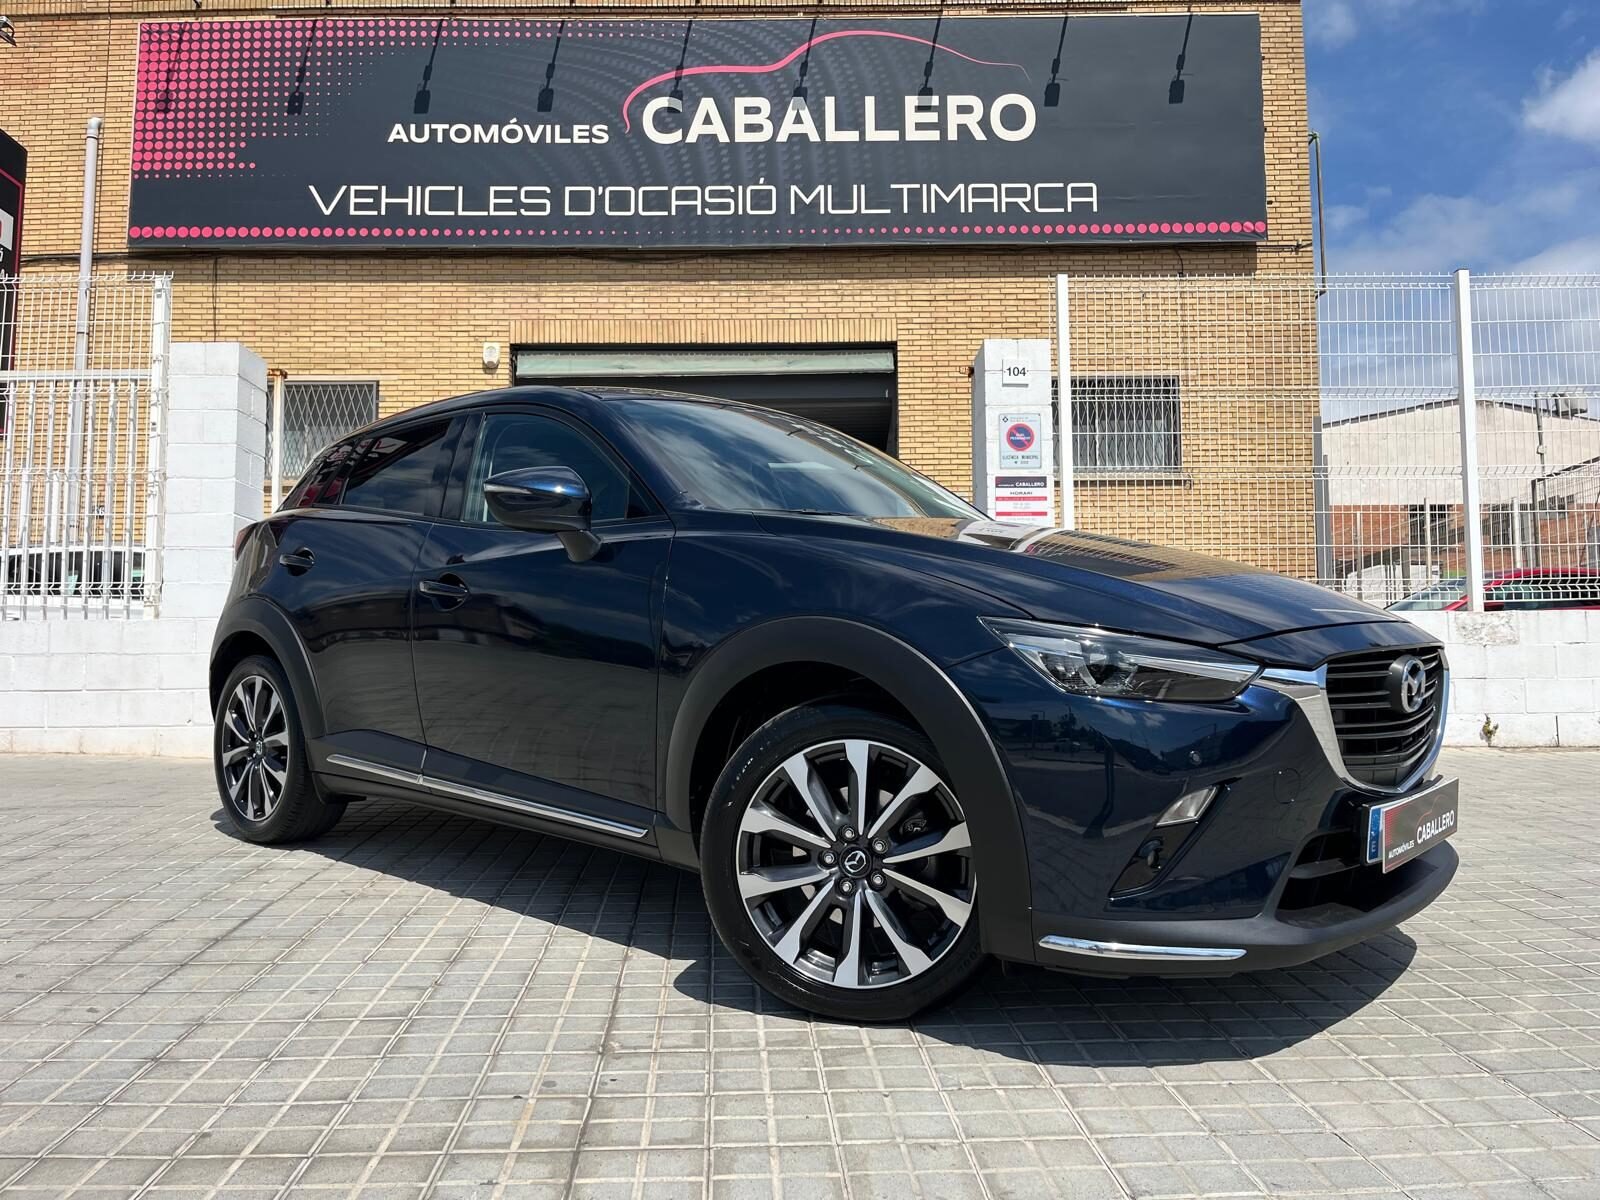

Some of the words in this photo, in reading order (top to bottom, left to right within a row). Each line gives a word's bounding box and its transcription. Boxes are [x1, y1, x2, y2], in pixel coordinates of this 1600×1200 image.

[387, 118, 609, 144] AUTOMÓVILES
[641, 94, 1037, 145] CABALLERO
[308, 185, 551, 216] VEHICLES
[564, 178, 777, 216] D'OCASIÓ
[790, 182, 1098, 214] MULTIMARCA
[1006, 366, 1027, 377] 104
[1416, 809, 1455, 844] CABALLERO
